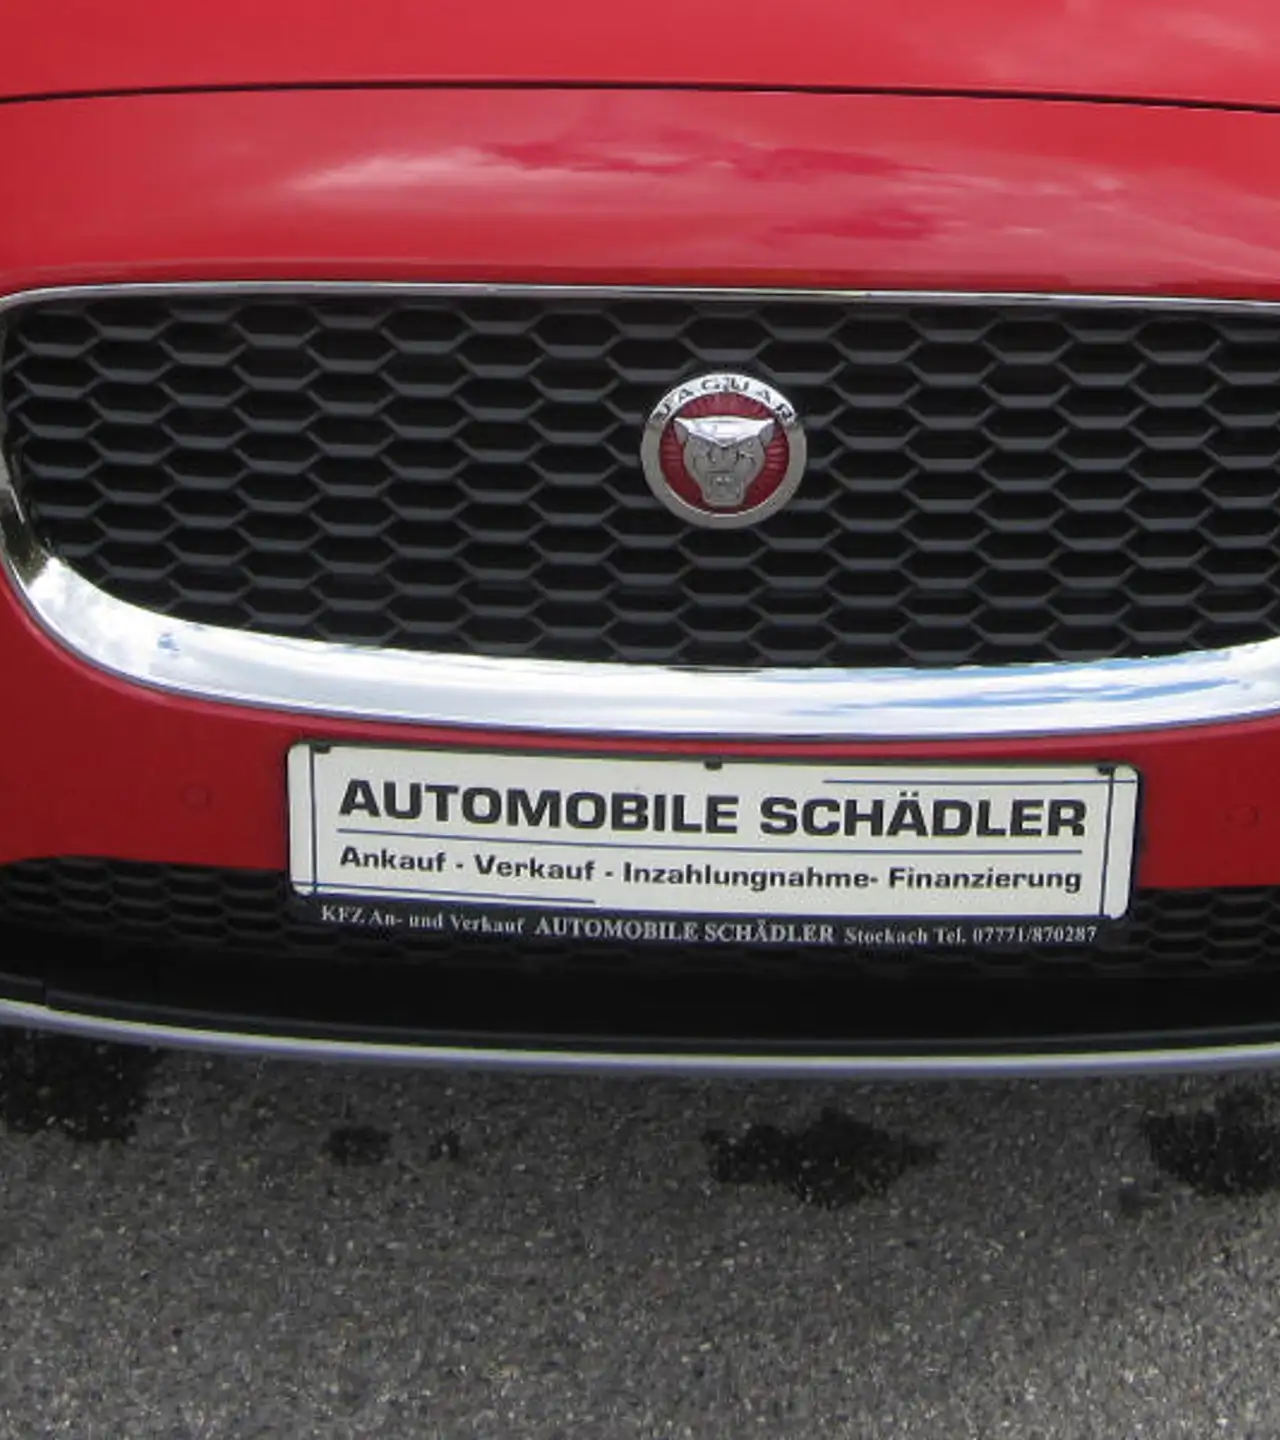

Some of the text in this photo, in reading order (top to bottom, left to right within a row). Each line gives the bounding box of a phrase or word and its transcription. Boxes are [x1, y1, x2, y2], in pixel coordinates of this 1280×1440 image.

[338, 778, 1088, 837] AUTOMOBILE SCHÄDLER
[339, 846, 447, 873] Ankauf
[473, 854, 596, 881] Verkauf
[888, 867, 1082, 893] Finanzierung
[321, 905, 1098, 945] KFZ An- und Verkauf AUTOMOBILE SCHÄDLER Stockach Tel. 07771/870287
